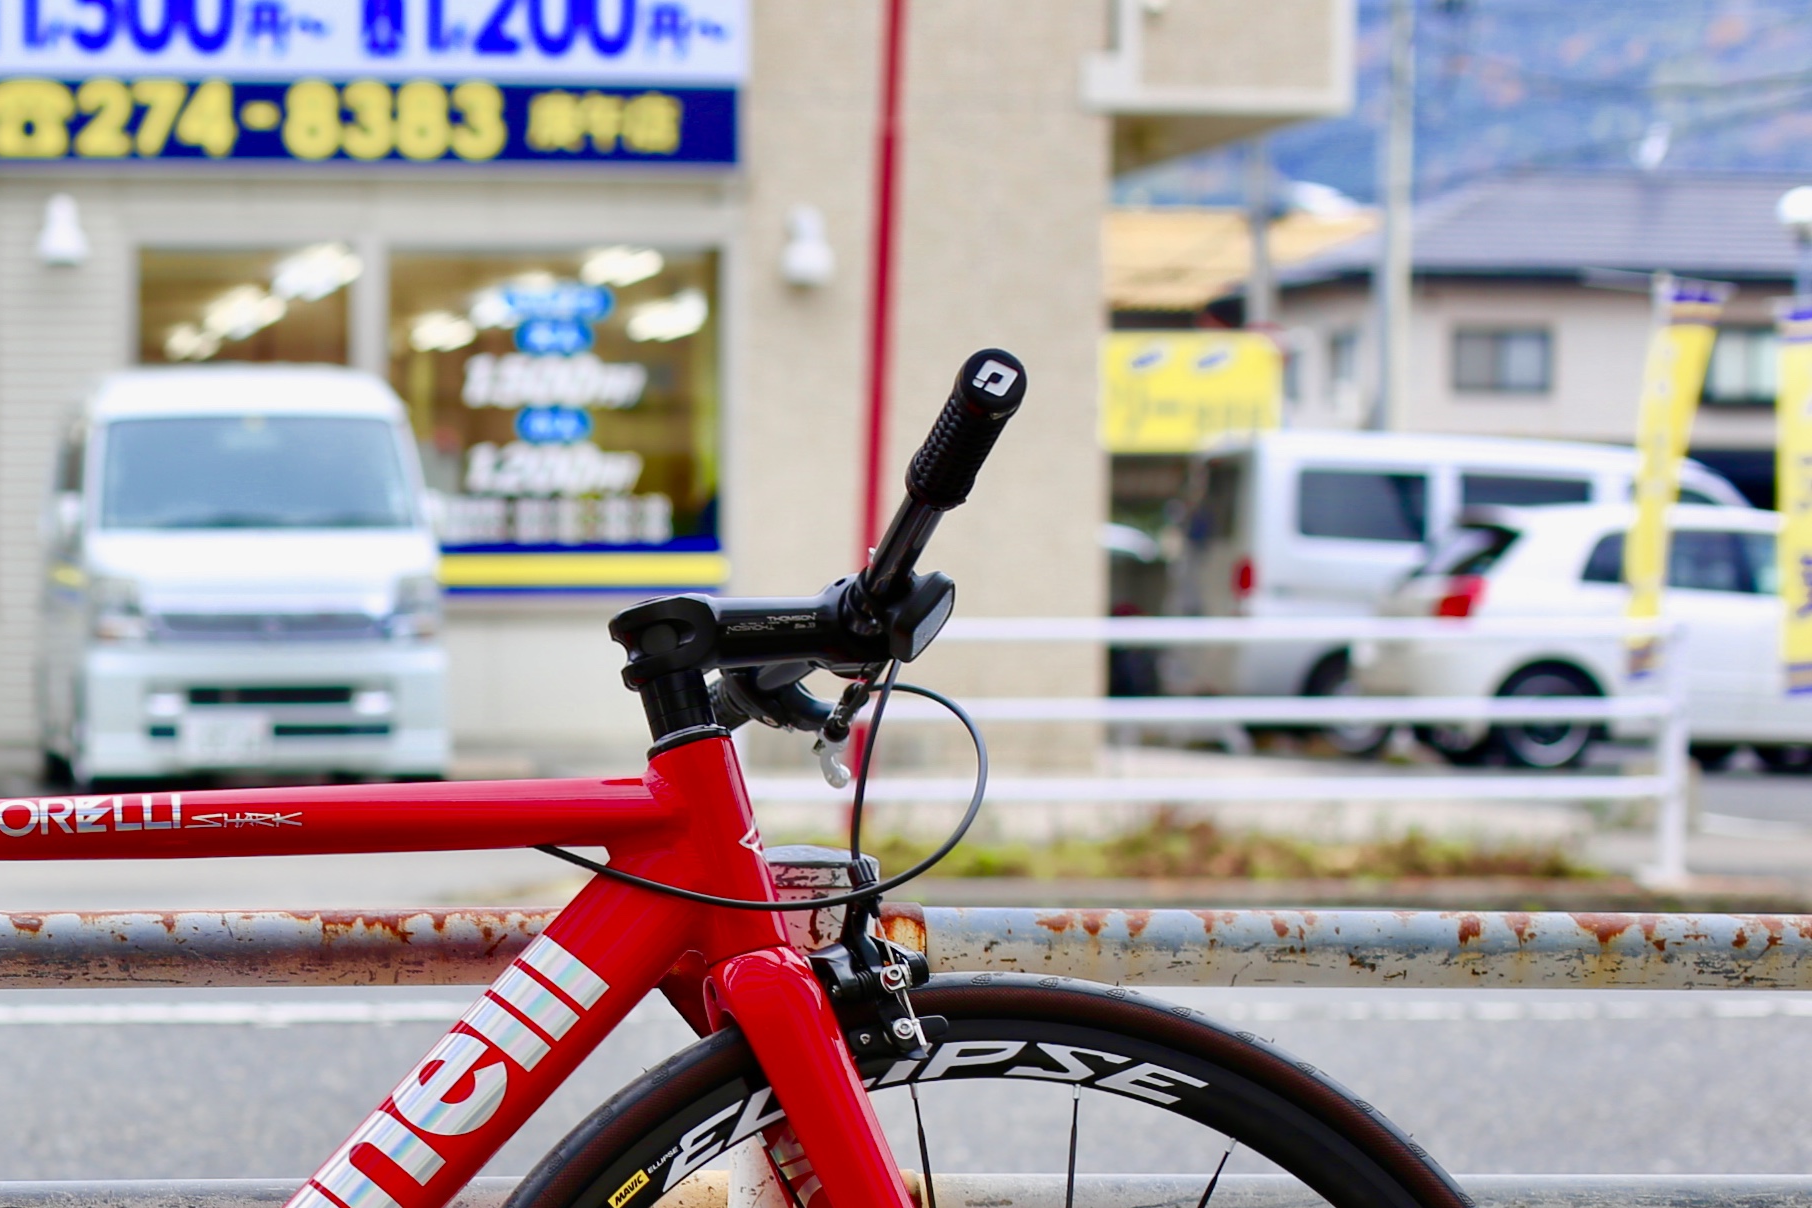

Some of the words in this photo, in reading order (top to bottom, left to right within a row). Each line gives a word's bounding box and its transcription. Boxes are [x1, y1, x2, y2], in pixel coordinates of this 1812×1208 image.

[766, 614, 816, 622] THOMSON
[184, 811, 303, 828] SHARK
[661, 1040, 1209, 1193] ELIPSE
[613, 1174, 646, 1208] MAVIC
[647, 1146, 681, 1174] ELLIPSE
